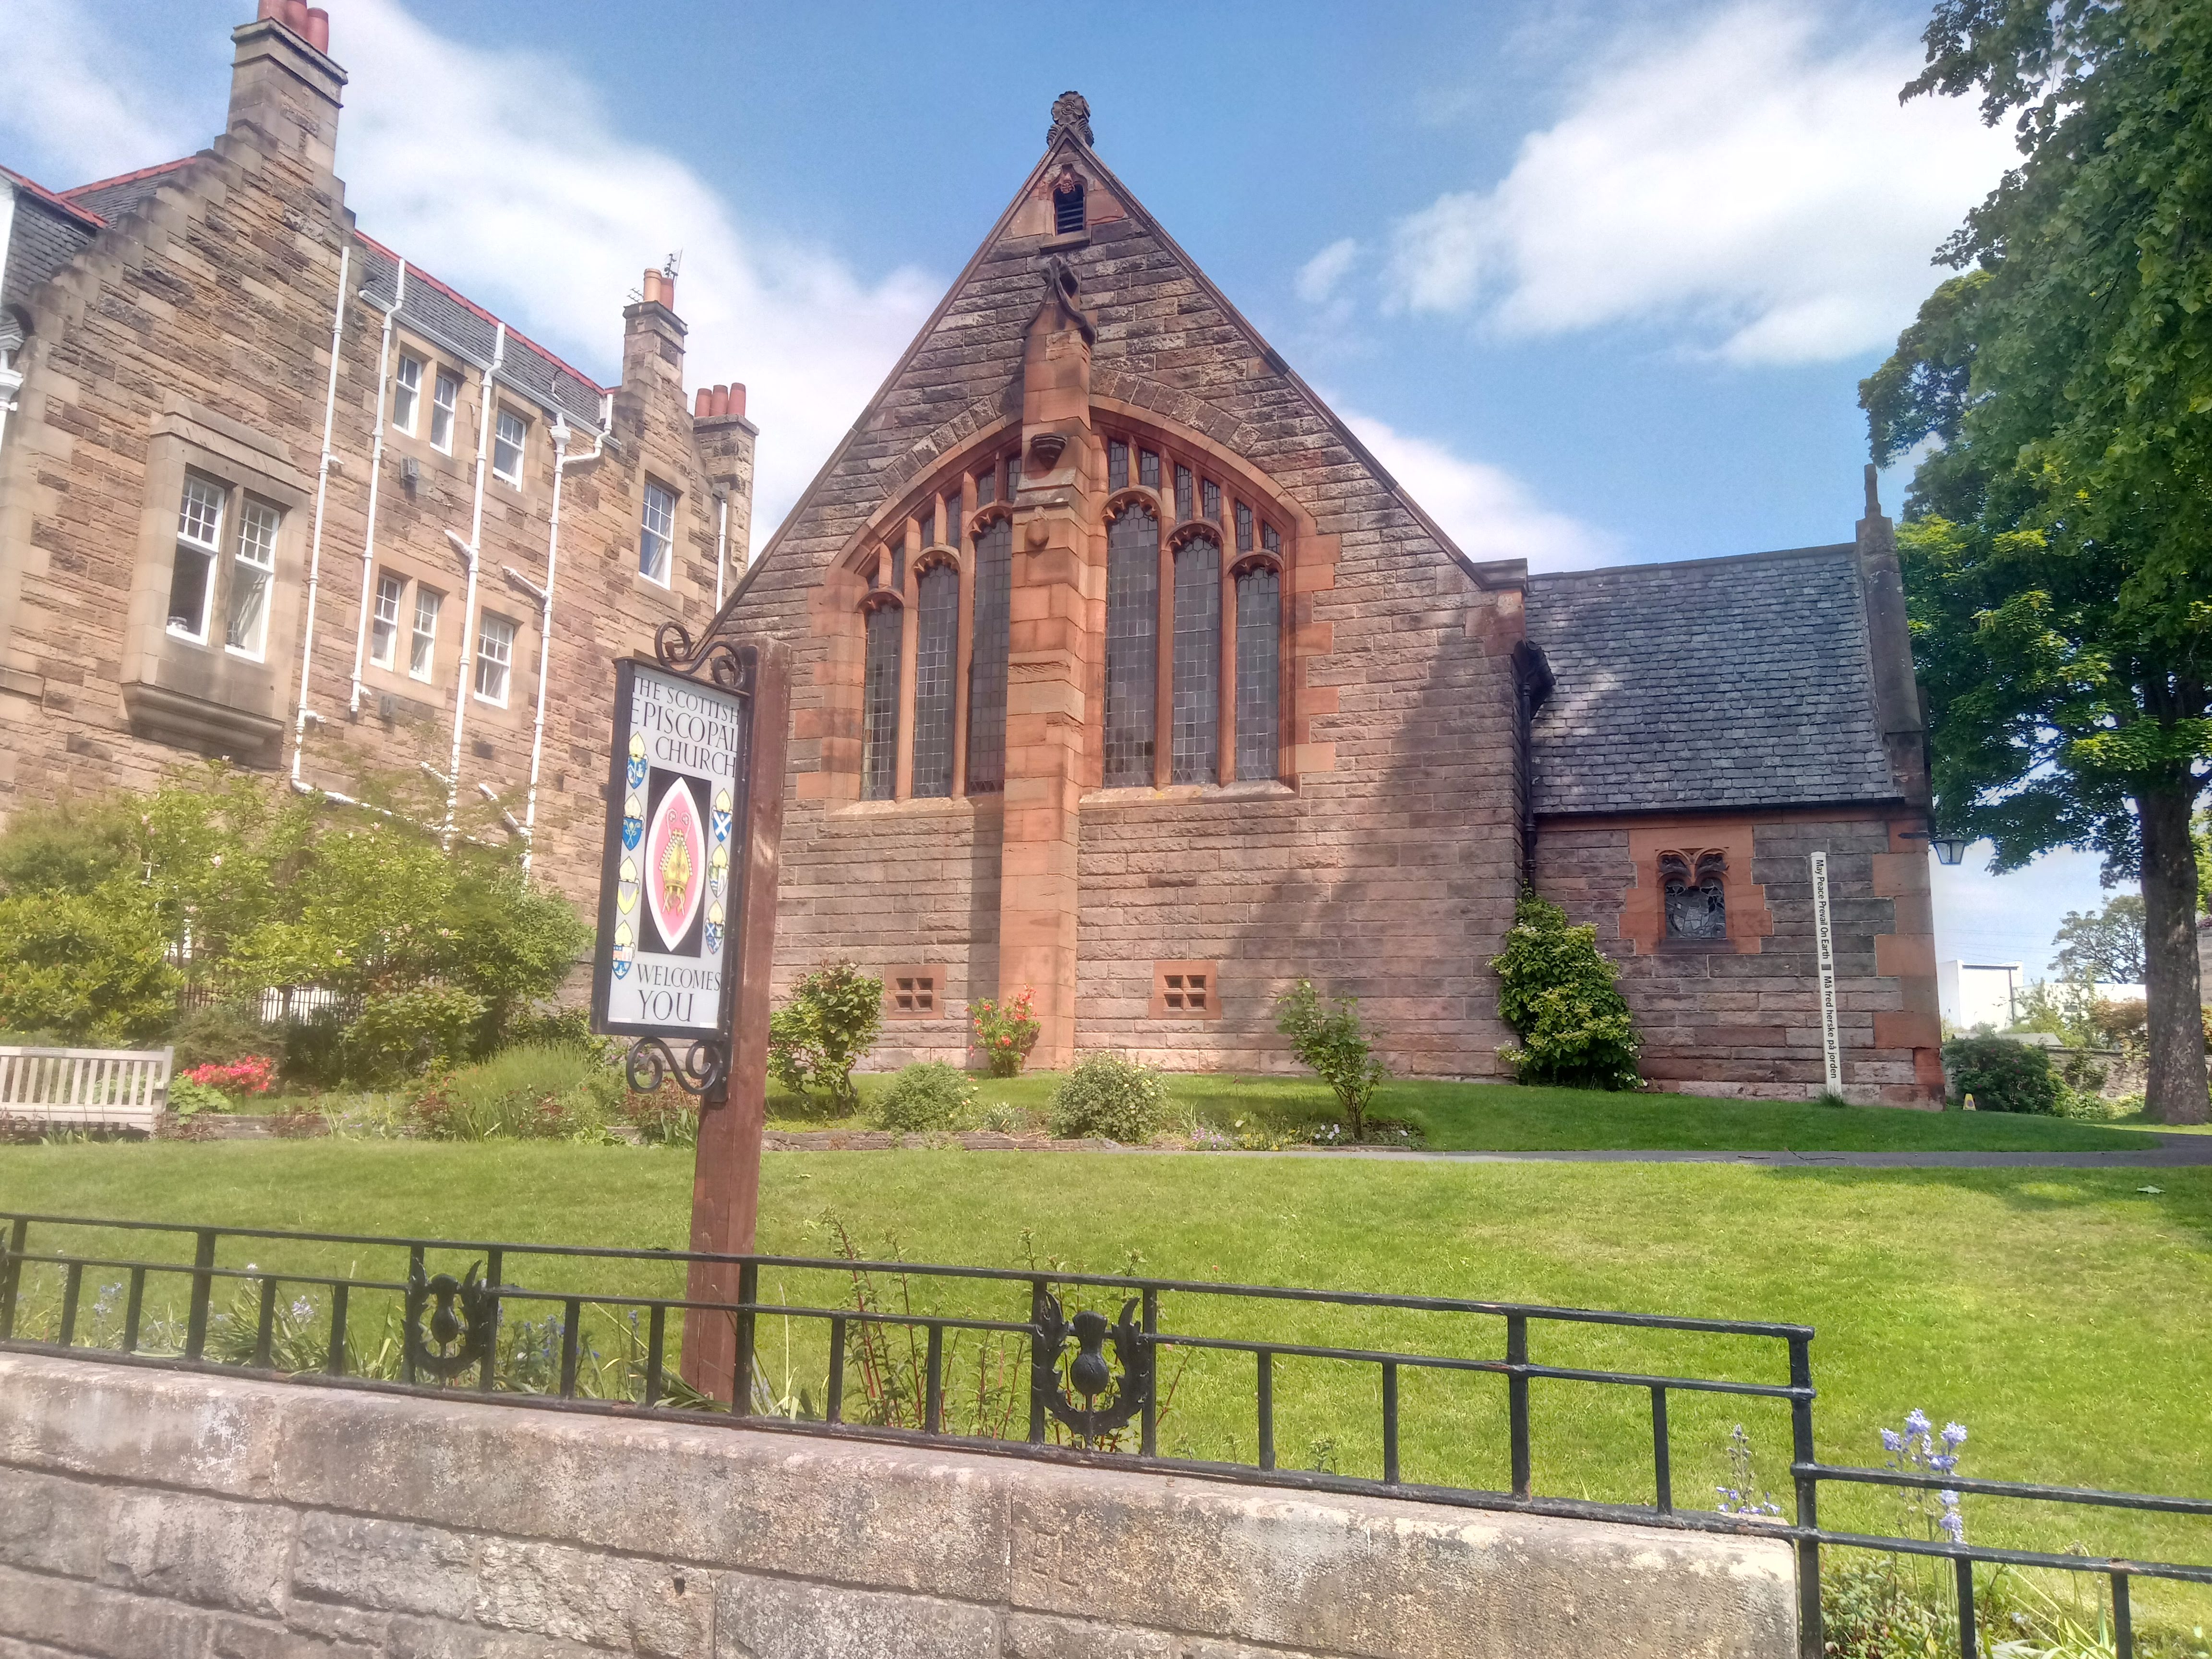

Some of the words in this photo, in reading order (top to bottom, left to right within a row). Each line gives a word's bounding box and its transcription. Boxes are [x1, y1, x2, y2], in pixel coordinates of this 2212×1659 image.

[667, 686, 739, 725] SCOTTISH
[630, 697, 738, 753] EPISCOPAL
[655, 736, 736, 778] CHURCH
[1815, 860, 1824, 875] May
[1819, 901, 1828, 925] Prevail
[1821, 927, 1828, 938] On
[1822, 939, 1830, 959] Earth
[637, 963, 721, 991] WELCOMES
[1824, 976, 1832, 988] Må
[637, 989, 694, 1022] YOU
[1825, 991, 1833, 1007] fred
[1827, 1010, 1835, 1037] herske
[1827, 1040, 1837, 1050] på
[1827, 1052, 1838, 1078] jorden
